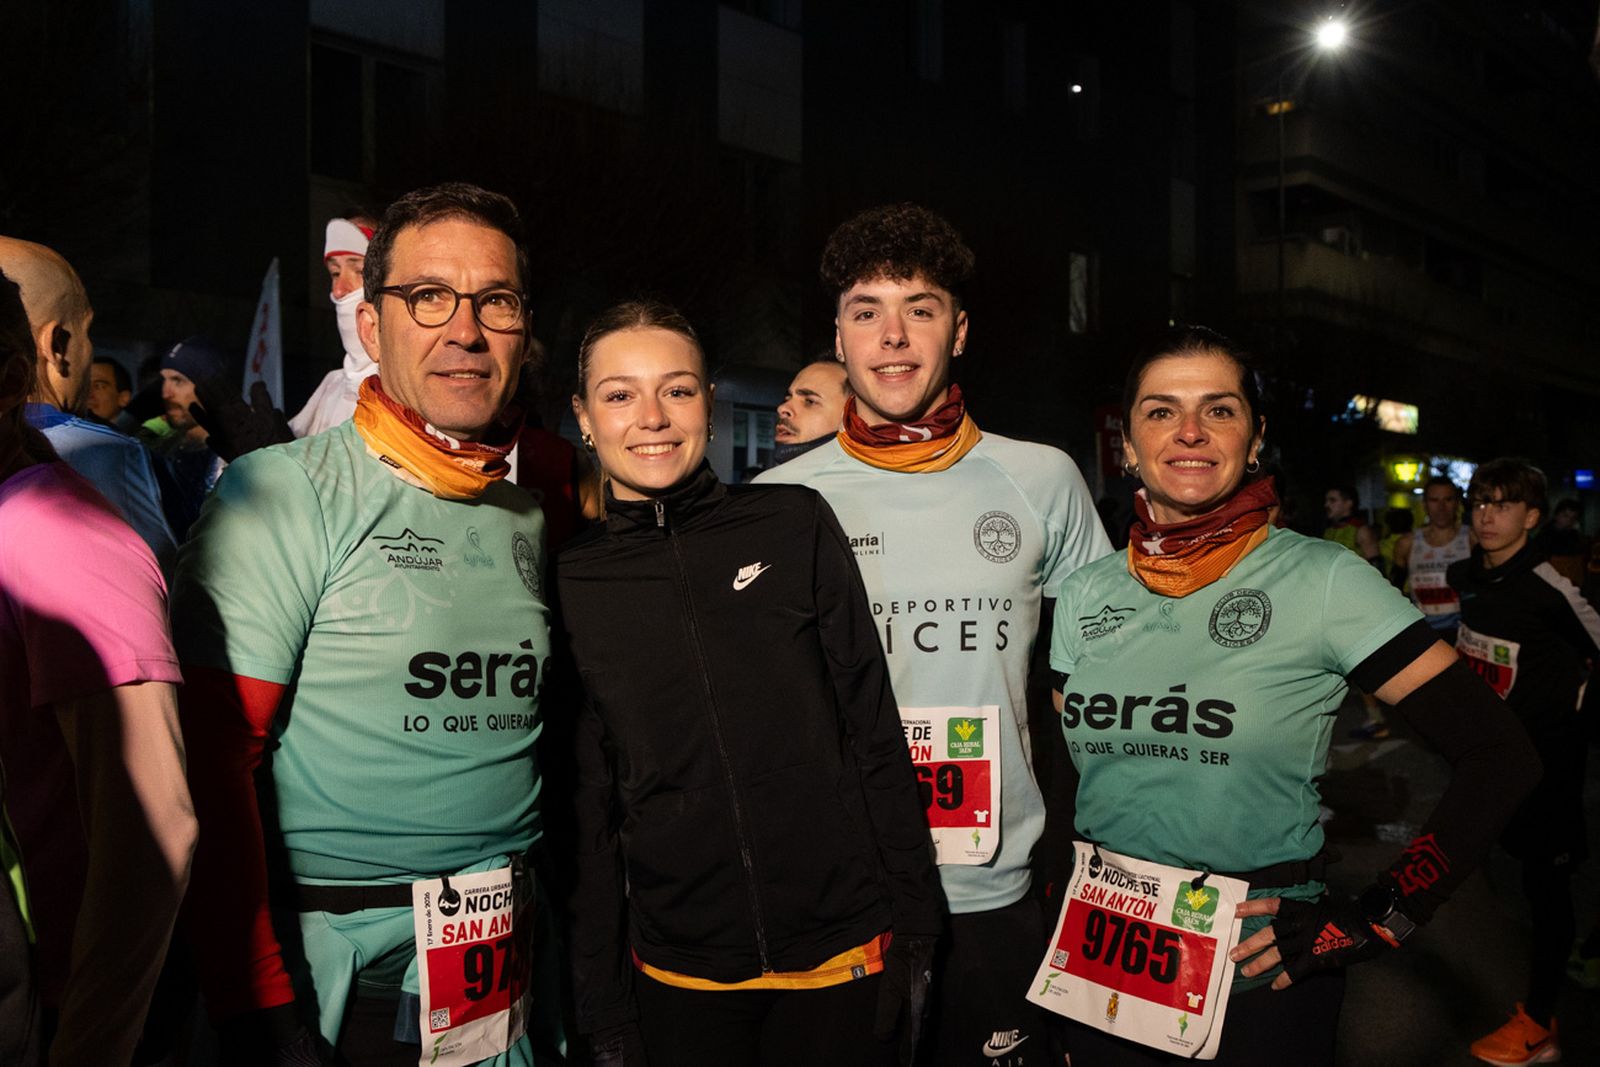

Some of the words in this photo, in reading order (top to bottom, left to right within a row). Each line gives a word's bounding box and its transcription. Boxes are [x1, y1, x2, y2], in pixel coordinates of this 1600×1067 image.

[849, 533, 879, 547] aría
[872, 598, 1013, 616] DEPORTIVO
[885, 617, 1010, 654] ÍCES
[404, 715, 430, 732] LO
[443, 714, 479, 733] QUE
[1063, 683, 1237, 739] serás
[912, 726, 932, 740] DE
[909, 741, 932, 762] ÓN
[1085, 741, 1115, 755] QUE
[1123, 742, 1189, 762] QUIERAS
[1200, 750, 1230, 766] SER
[913, 763, 963, 811] 69
[465, 889, 512, 914] NOCH
[1080, 883, 1107, 907] SAN
[1105, 895, 1158, 920] ANTÓN
[1140, 881, 1161, 897] DE
[441, 918, 483, 945] SAN
[488, 911, 512, 937] AN
[1081, 908, 1183, 984] 9765
[1312, 936, 1354, 955] adidas
[464, 937, 514, 1001] 97
